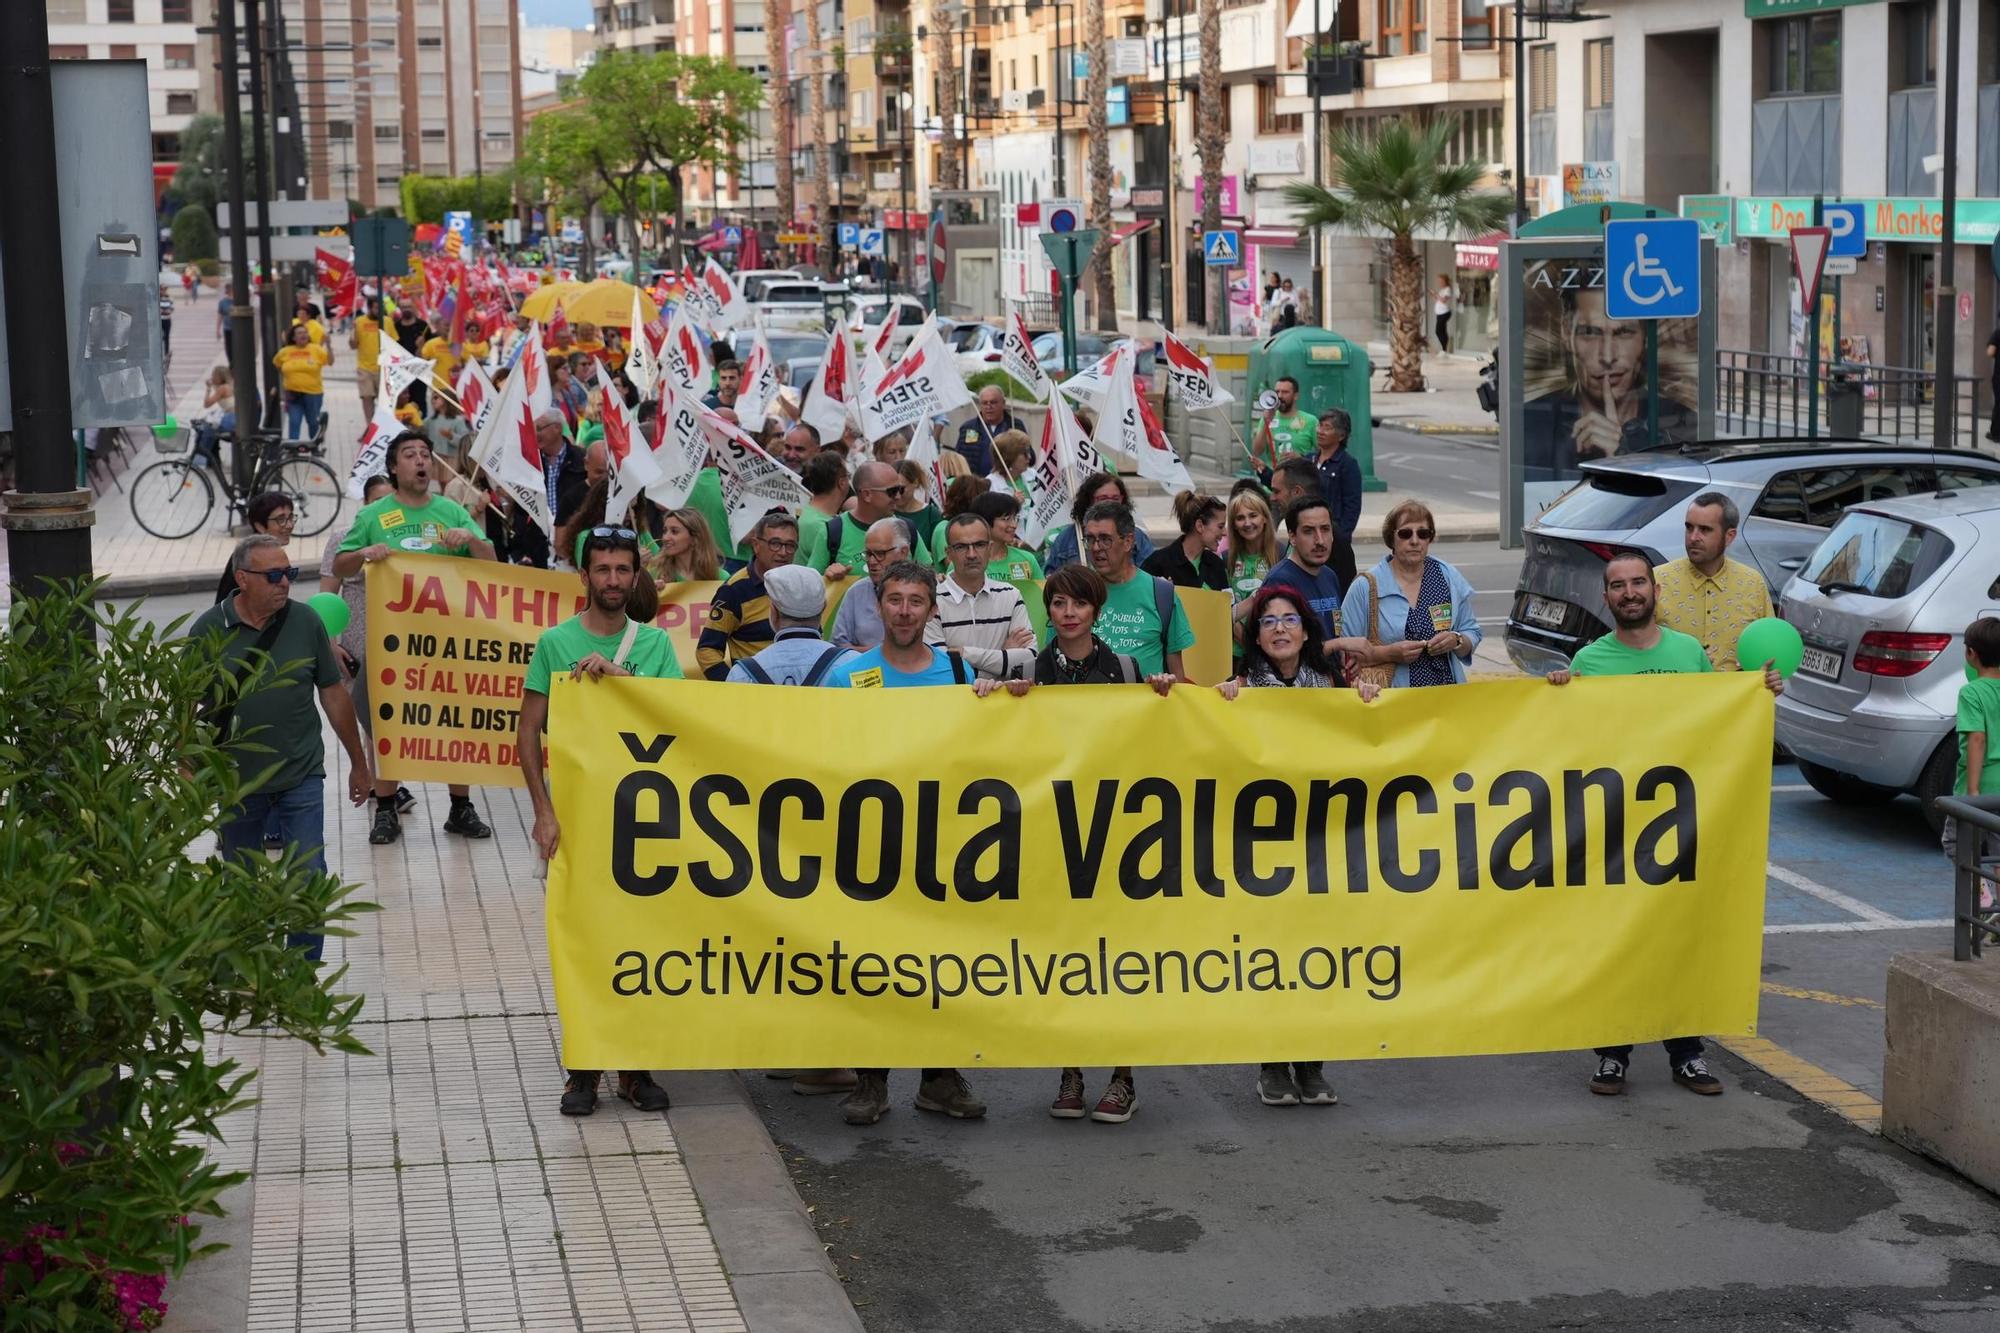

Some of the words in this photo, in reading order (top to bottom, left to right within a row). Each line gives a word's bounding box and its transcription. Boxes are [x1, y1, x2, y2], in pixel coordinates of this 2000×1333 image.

[1568, 167, 1612, 180] ATLAS
[842, 226, 855, 242] P
[1823, 209, 1855, 251] P
[1876, 202, 1943, 236] Marke
[1465, 254, 1489, 267] ATLAS
[1532, 268, 1605, 289] AZZ
[1006, 334, 1042, 381] STEPV
[385, 573, 450, 616] JA
[465, 580, 560, 627] N'HI
[407, 634, 437, 657] NO
[442, 637, 457, 659] A
[464, 638, 503, 662] LES
[508, 641, 536, 664] RE
[404, 663, 429, 691] SÍ
[430, 671, 458, 694] AL
[402, 703, 432, 726] NO
[437, 705, 464, 728] AL
[471, 707, 521, 732] DIST
[399, 737, 491, 765] MILLORA
[1052, 765, 1698, 900] valenciana
[612, 934, 1402, 1010] activistespelvalencia.org
